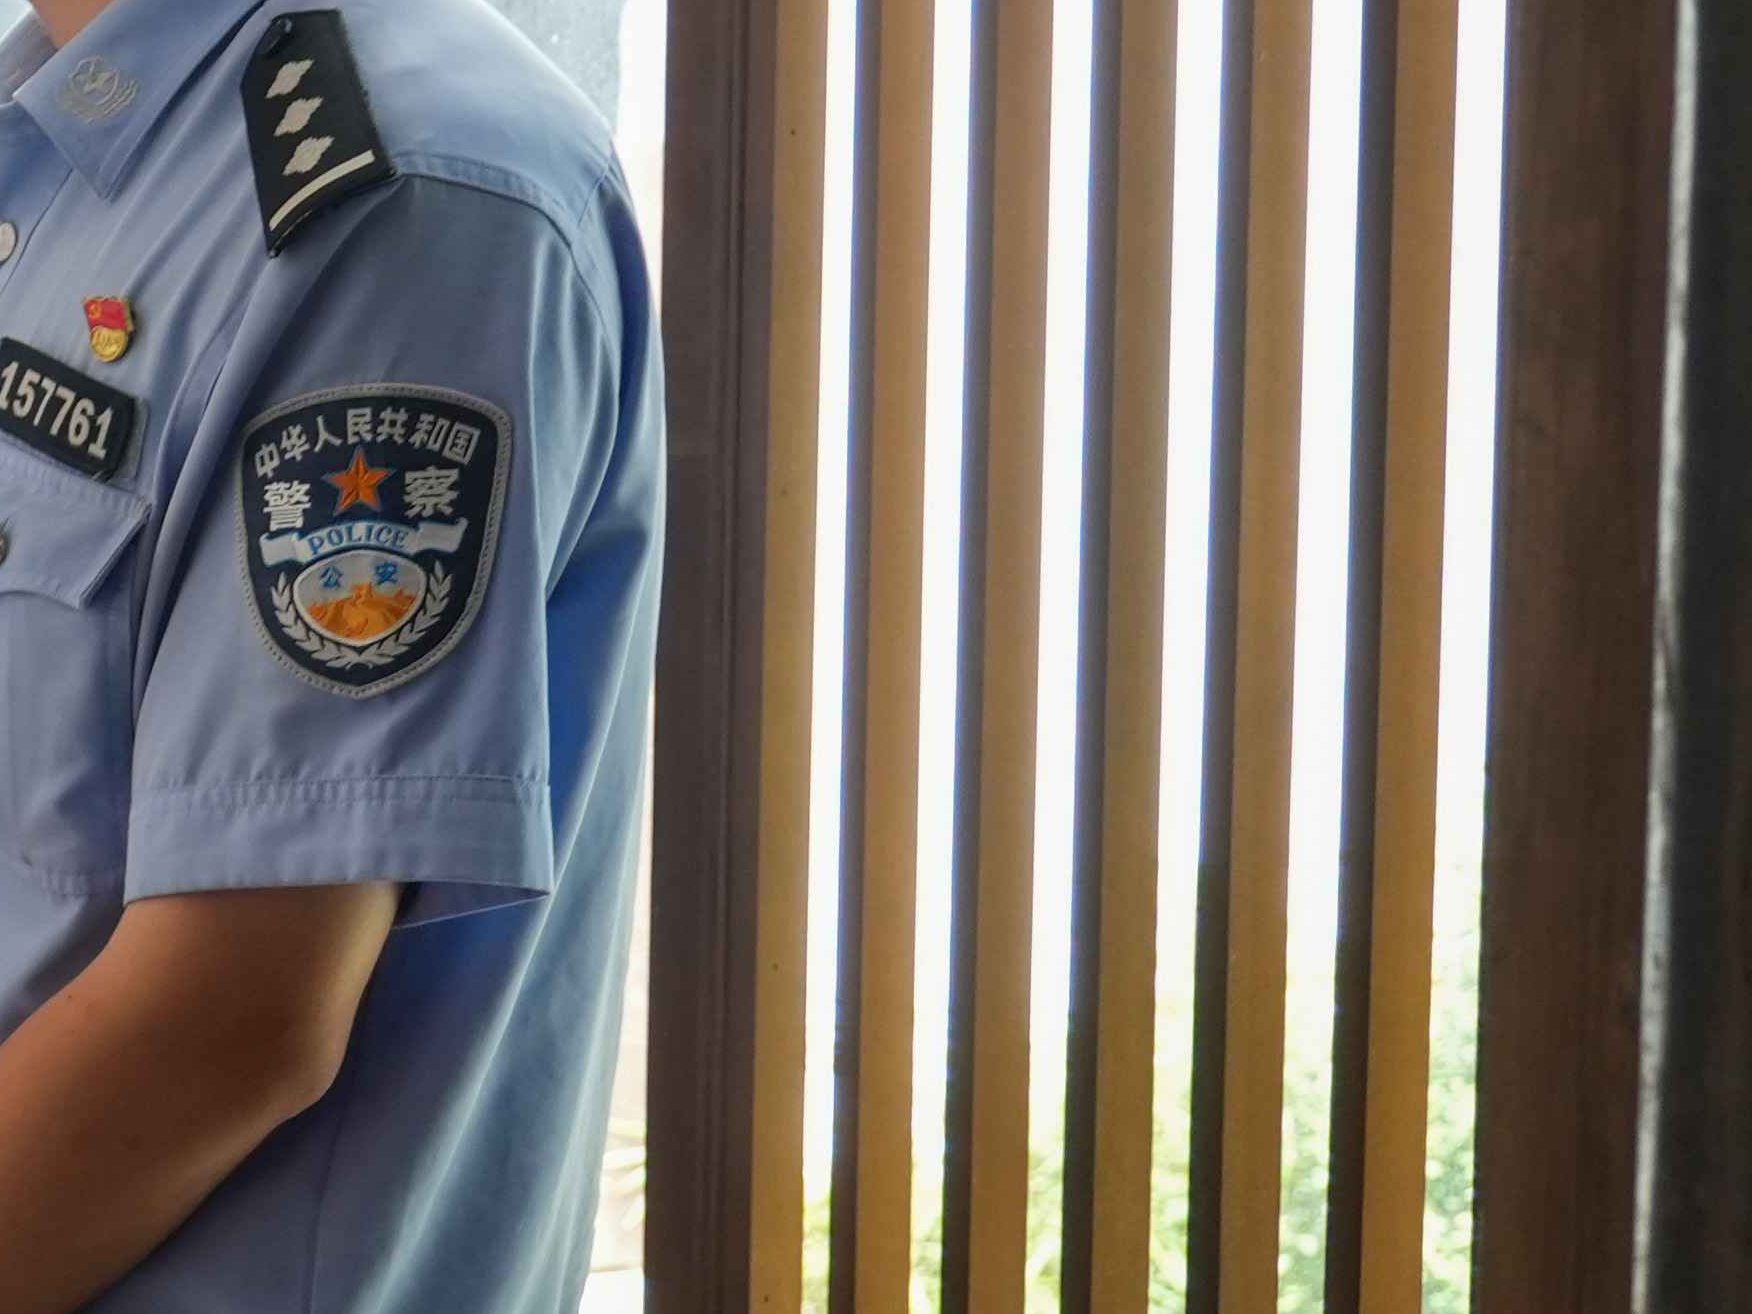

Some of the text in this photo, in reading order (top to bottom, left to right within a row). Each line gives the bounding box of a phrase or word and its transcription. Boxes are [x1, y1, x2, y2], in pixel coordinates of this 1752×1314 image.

[254, 406, 481, 479] 中华人民共和国
[263, 465, 460, 532] 警 察
[307, 522, 412, 556] POLICE
[319, 560, 399, 591] 公 安
